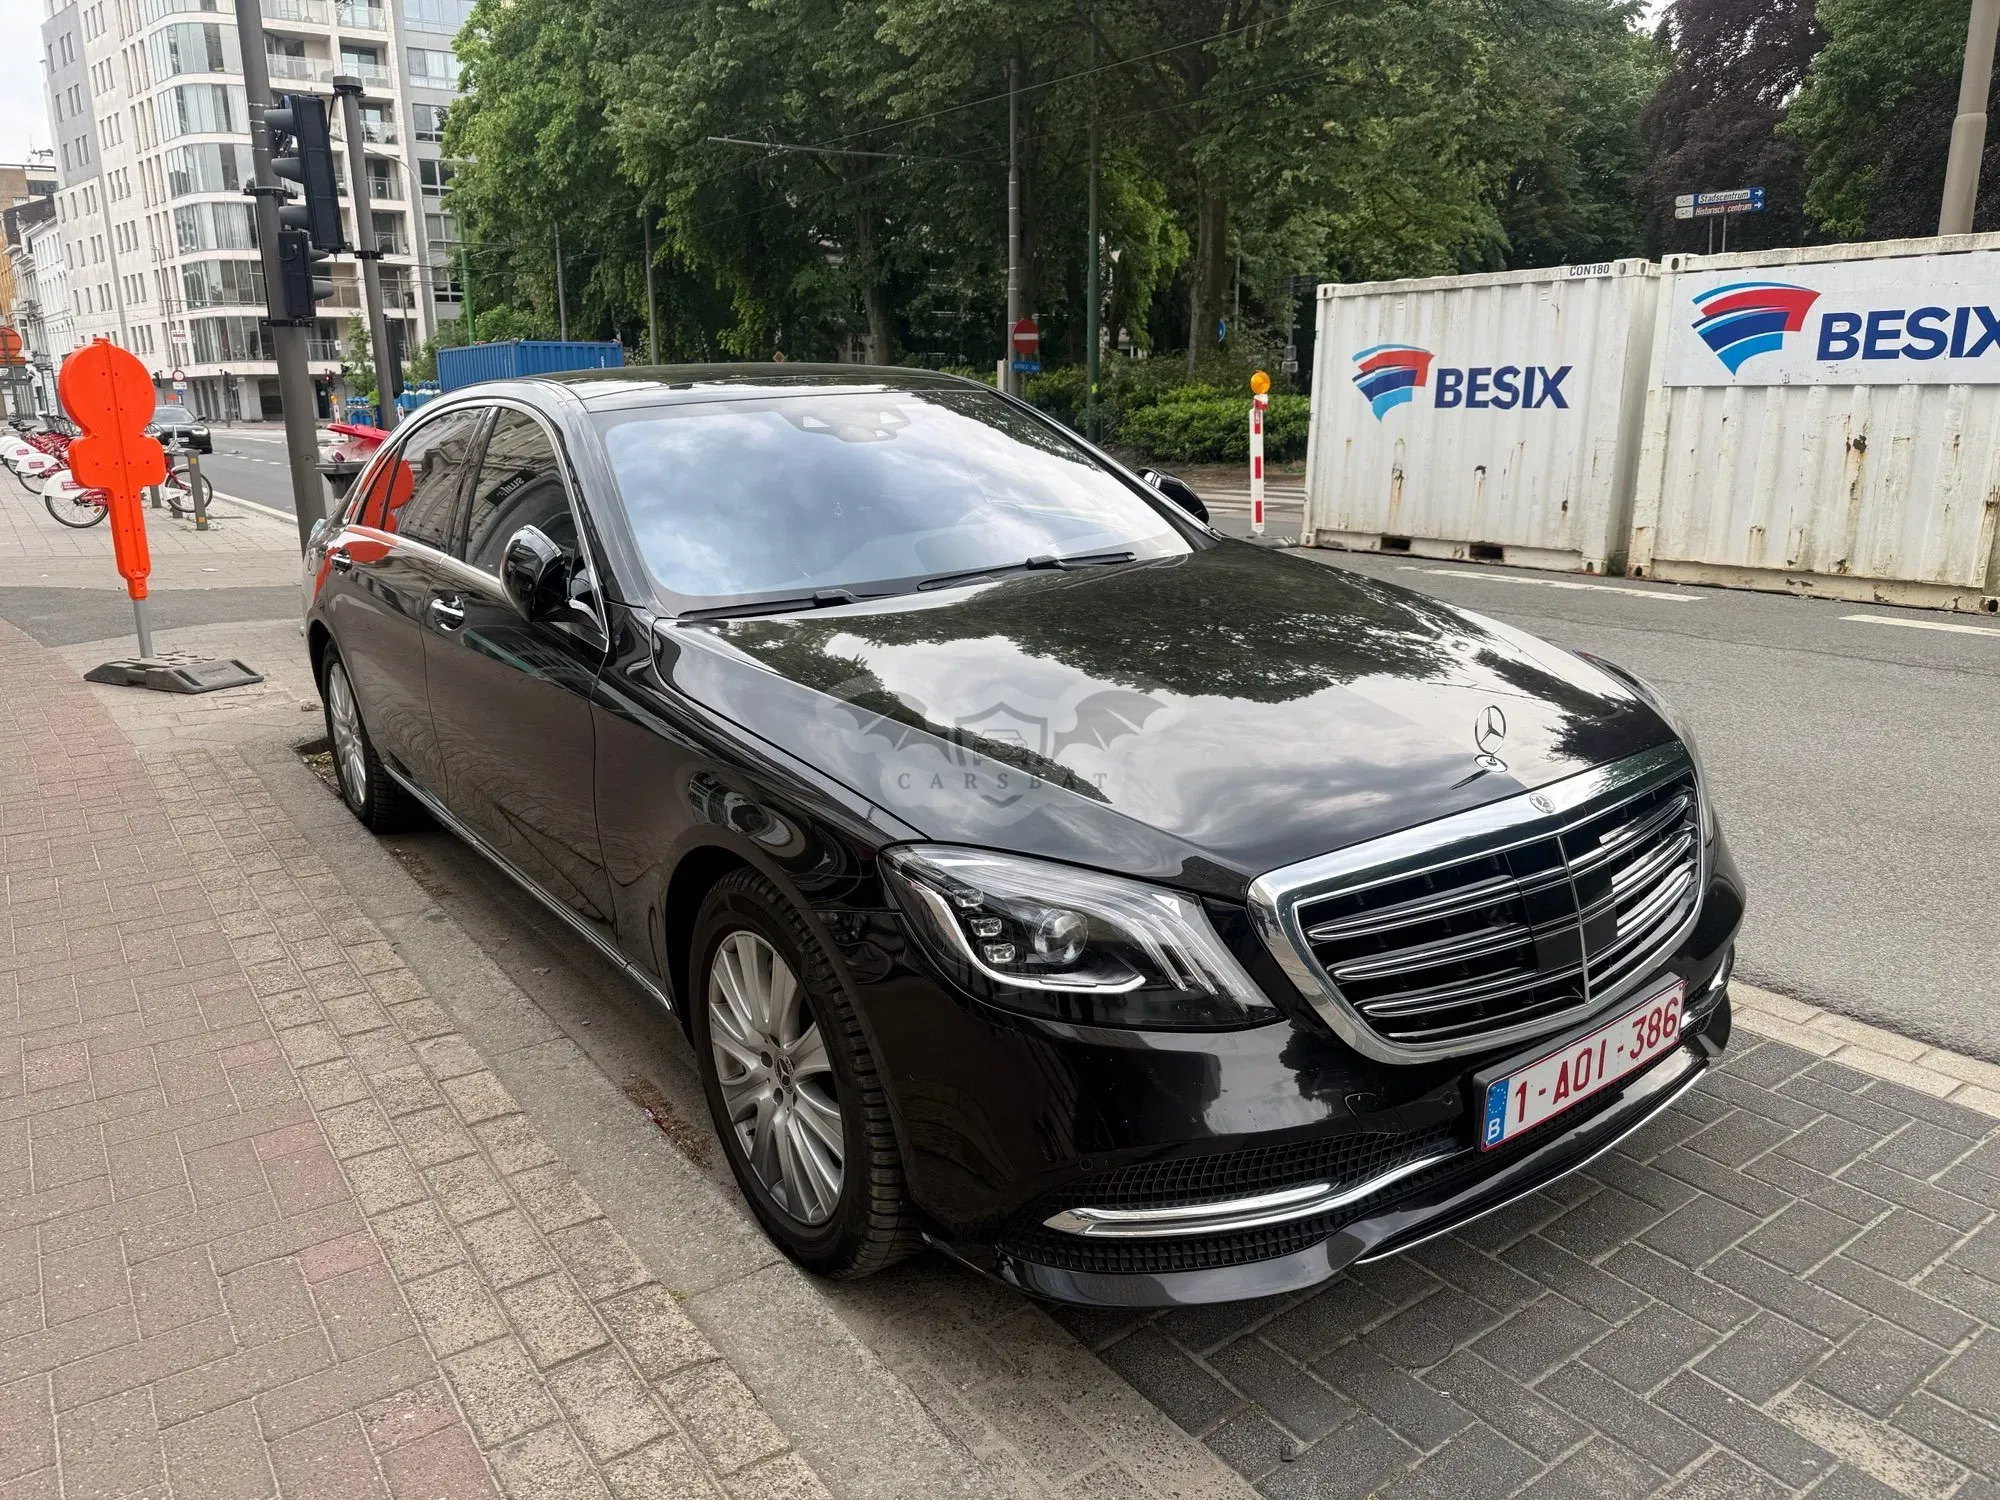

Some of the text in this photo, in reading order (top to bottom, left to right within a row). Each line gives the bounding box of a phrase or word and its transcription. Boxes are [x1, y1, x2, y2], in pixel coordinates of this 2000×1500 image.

[1700, 192, 1749, 203] Stadscentrum
[1695, 203, 1752, 216] Historisch centrum
[1569, 263, 1610, 277] CON180
[1433, 365, 1574, 410] BESIX
[1487, 1117, 1501, 1141] B
